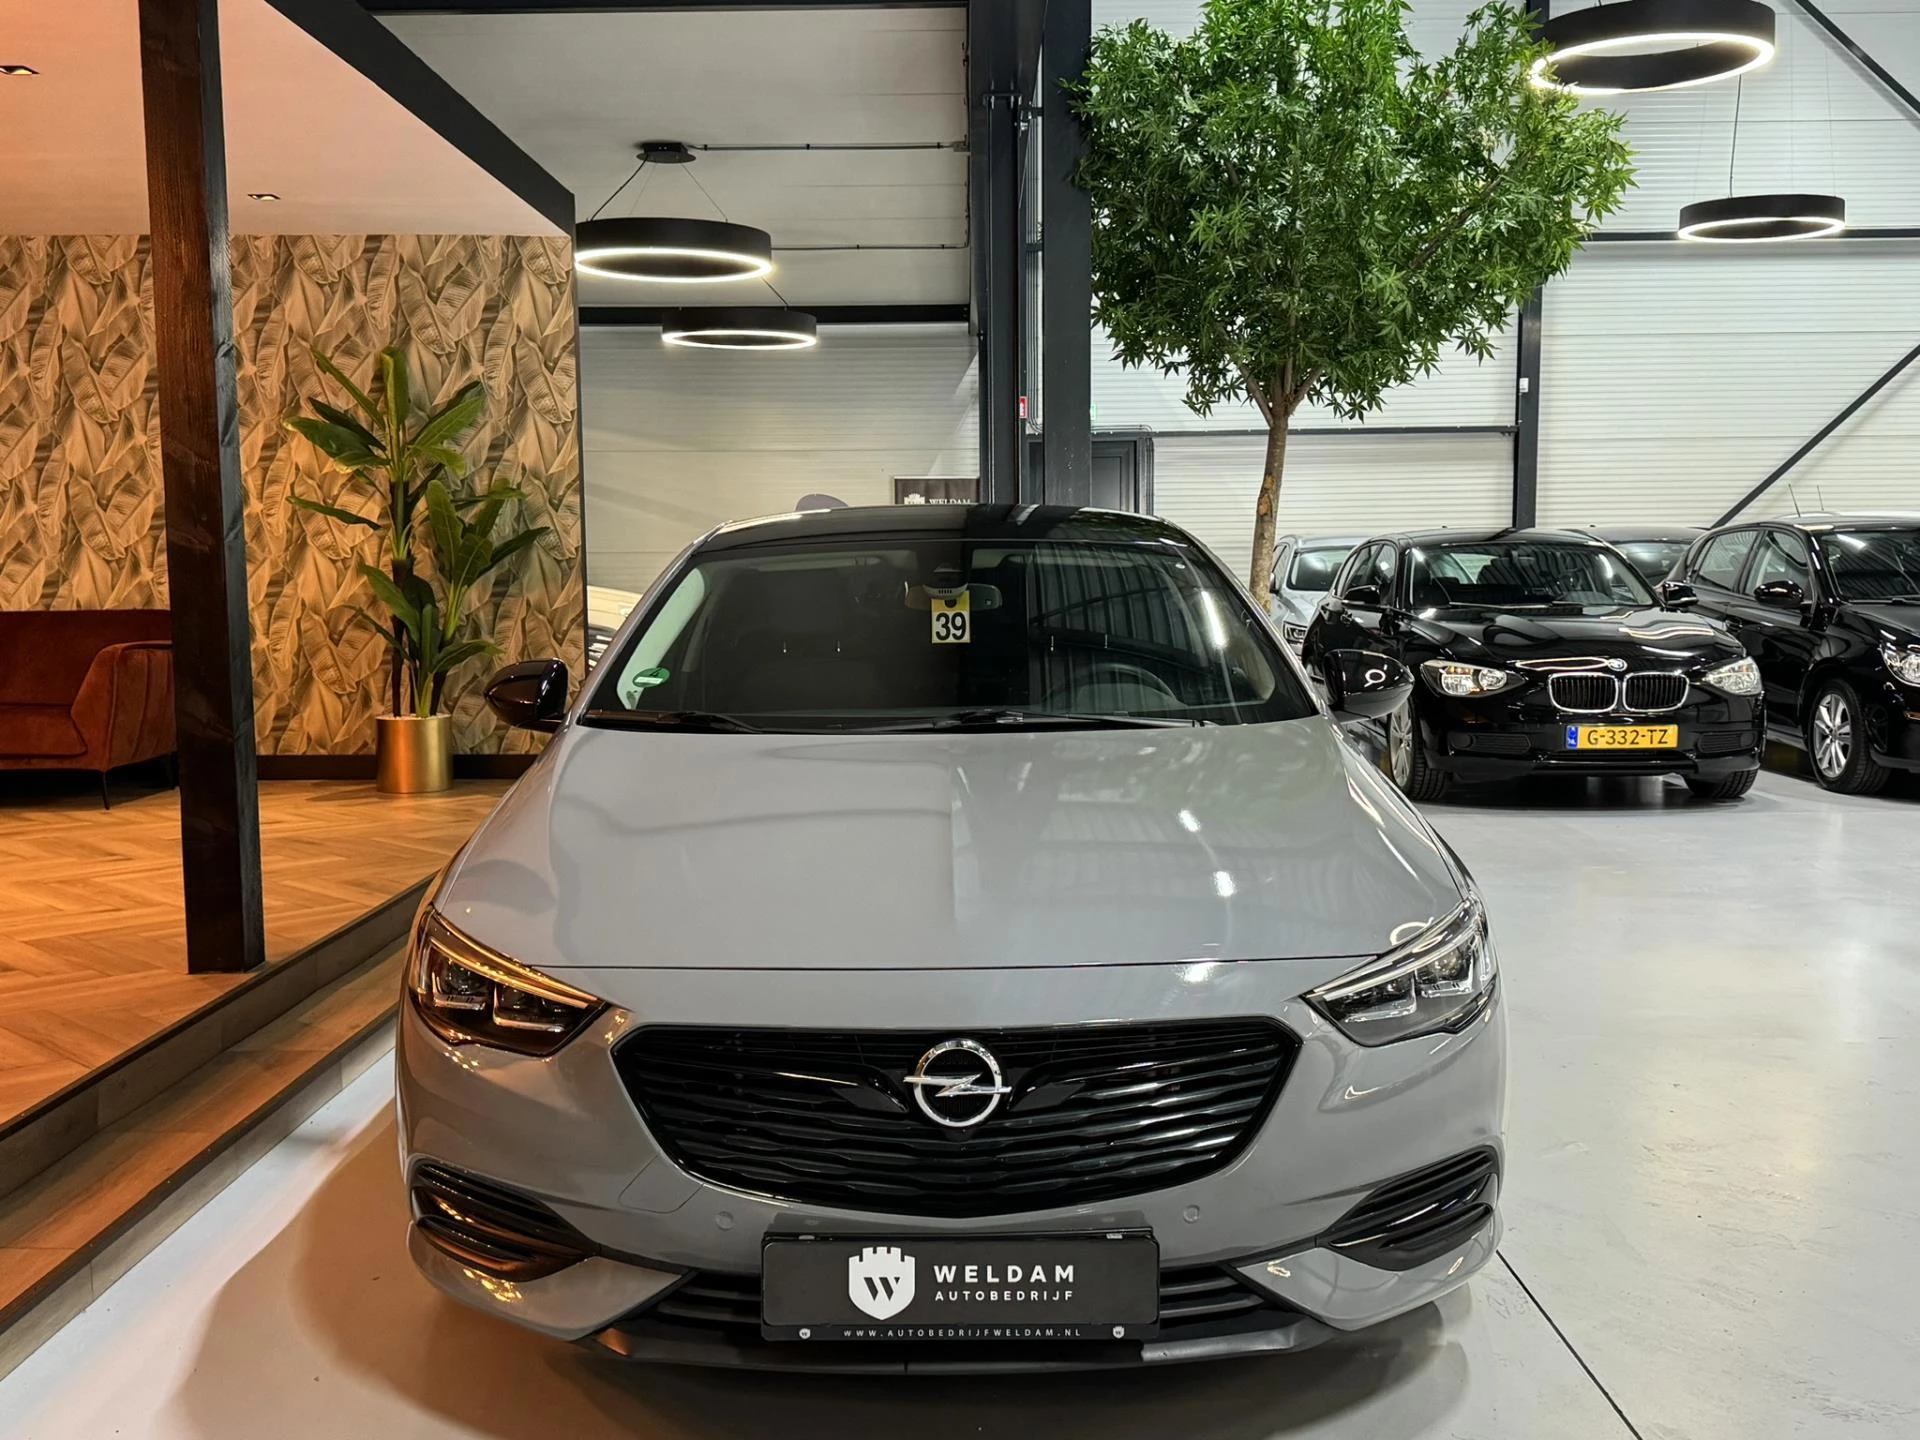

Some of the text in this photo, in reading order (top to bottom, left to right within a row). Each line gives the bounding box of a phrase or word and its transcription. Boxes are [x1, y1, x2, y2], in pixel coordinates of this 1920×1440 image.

[936, 612, 967, 641] 39
[1587, 729, 1668, 745] G-332-TZ
[933, 1265, 1074, 1283] WELDAM
[934, 1291, 1074, 1301] AUTOBEDRIJF
[843, 1328, 1081, 1337] WWW.AUTOBEDRIJFWELDAM.NL
